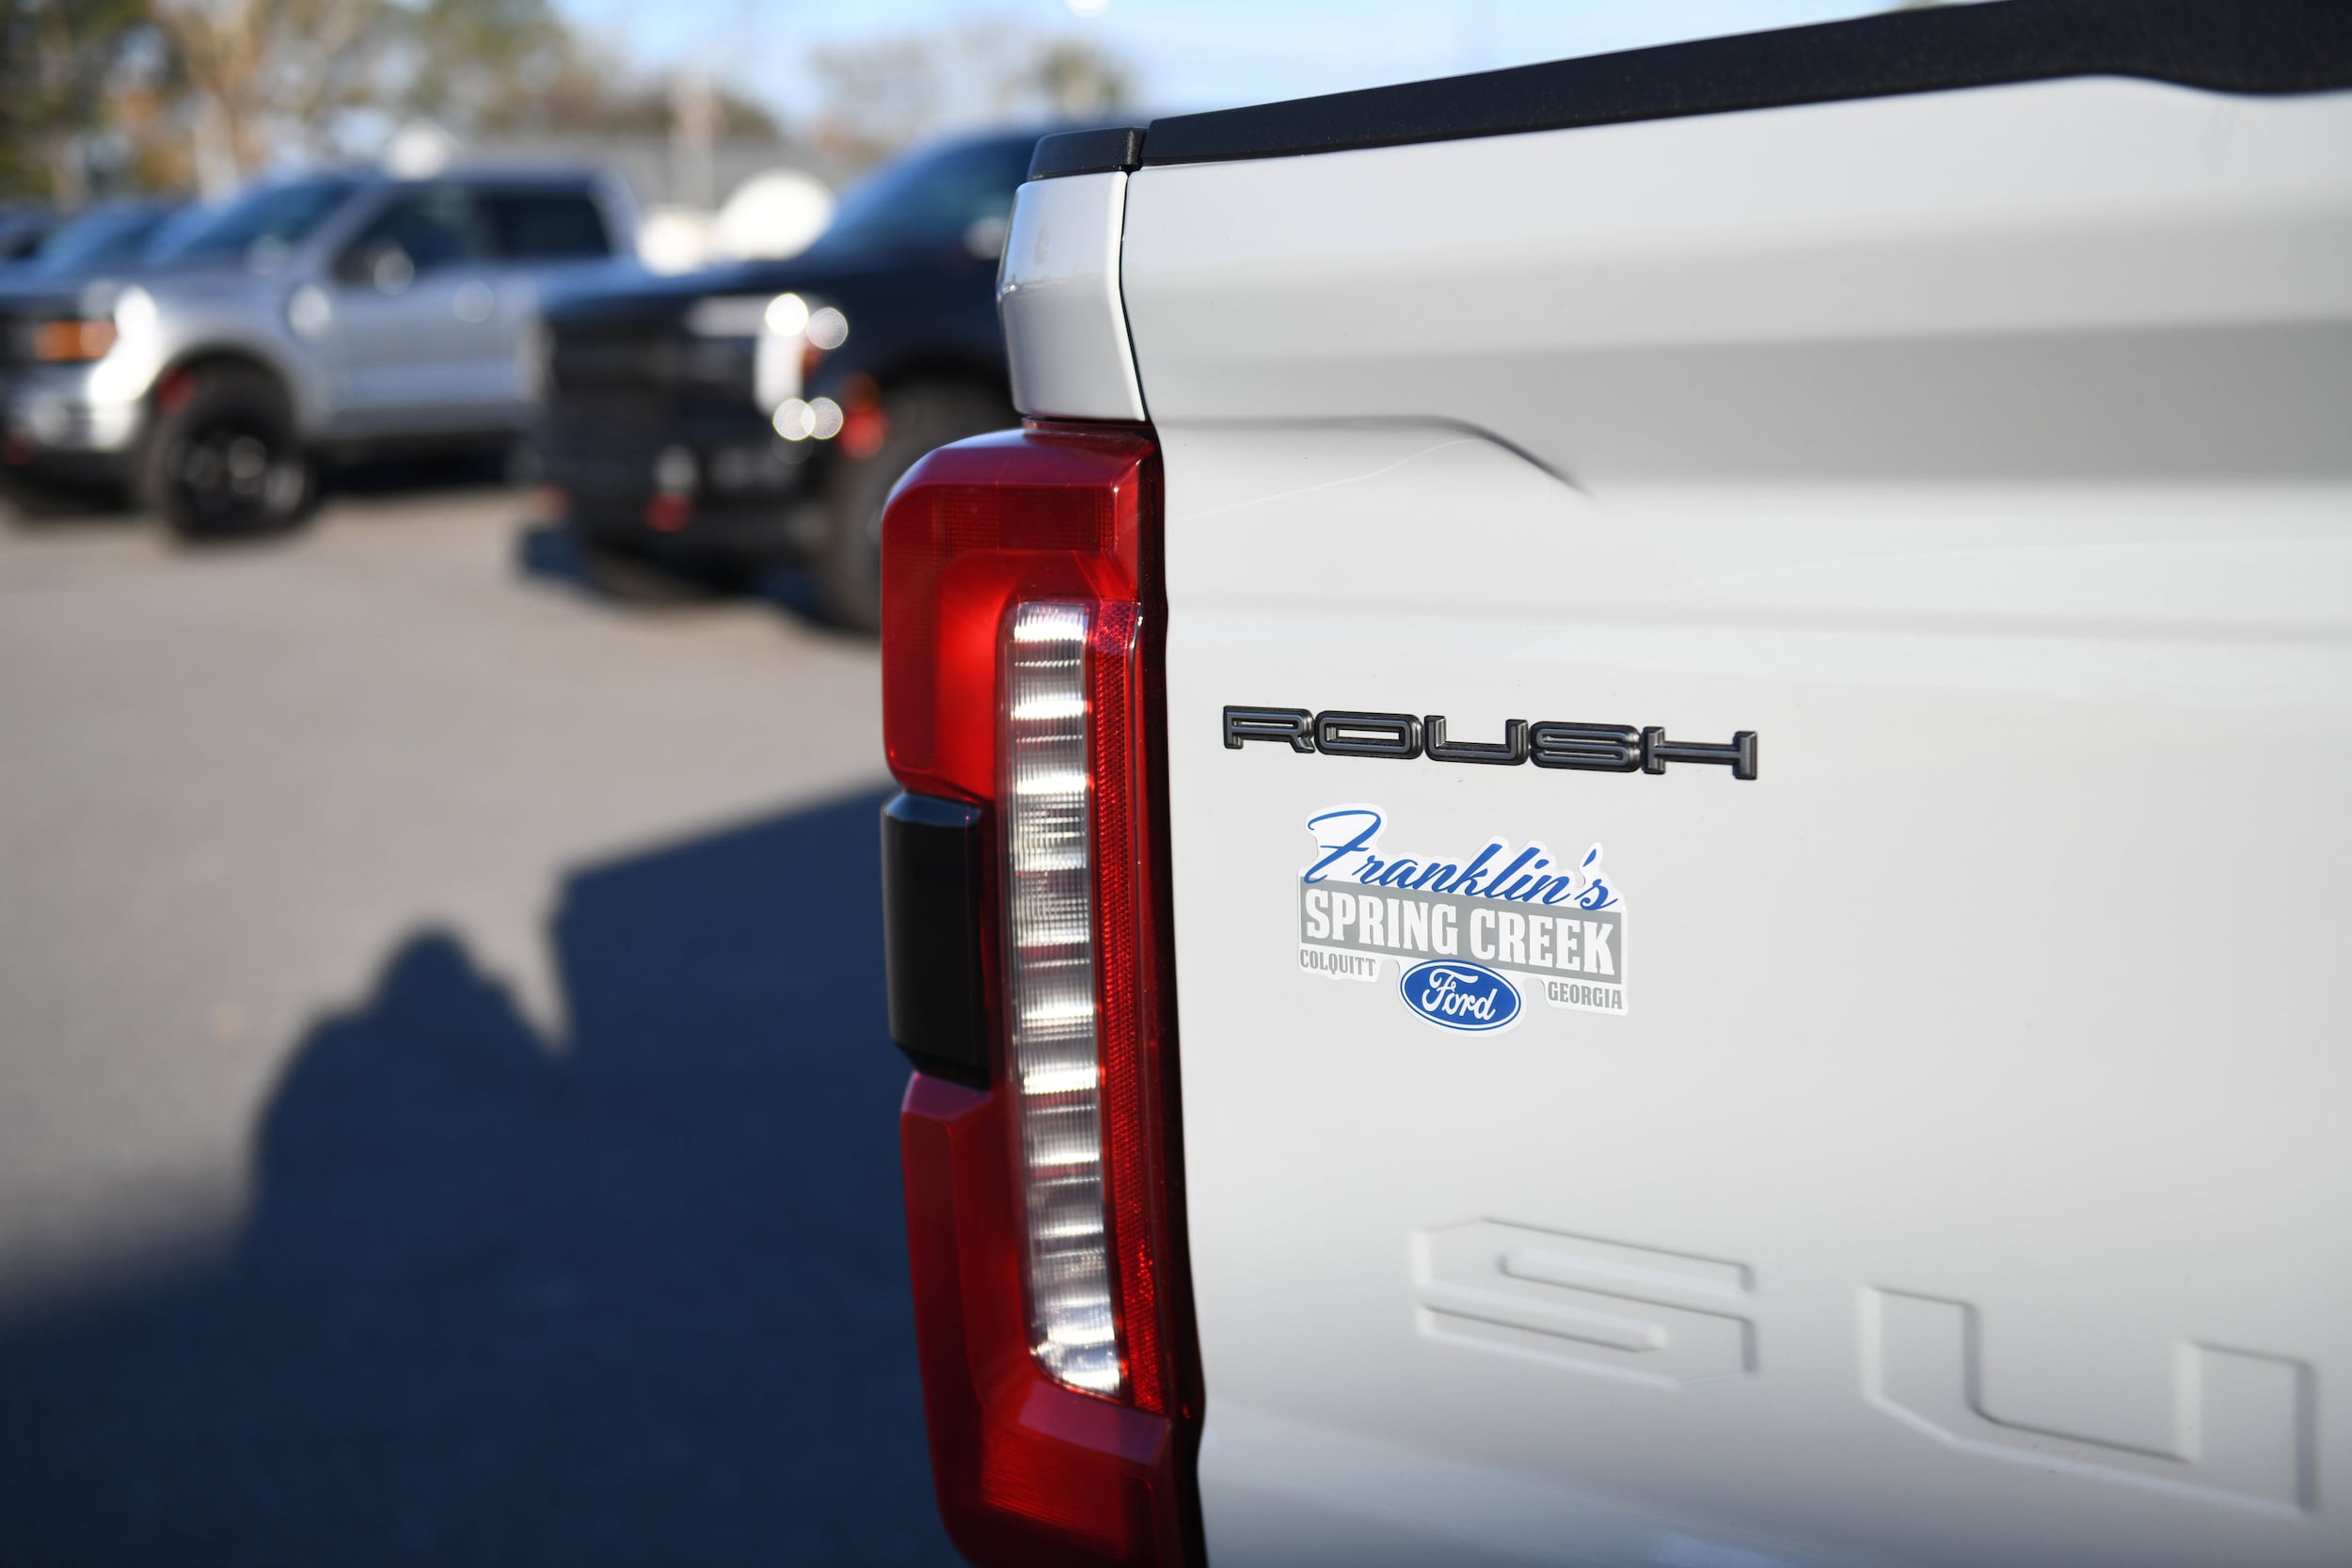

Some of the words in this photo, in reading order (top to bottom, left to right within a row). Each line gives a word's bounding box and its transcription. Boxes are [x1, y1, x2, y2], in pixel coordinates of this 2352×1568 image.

[1223, 705, 1758, 780] ROUSH
[1304, 809, 1618, 911] Franklin's
[1299, 948, 1376, 978] COLQUITT
[1305, 889, 1459, 957] SPRING
[1470, 909, 1615, 976] CREEK
[1422, 973, 1496, 1022] Ford
[1547, 980, 1623, 1010] GEORGIA
